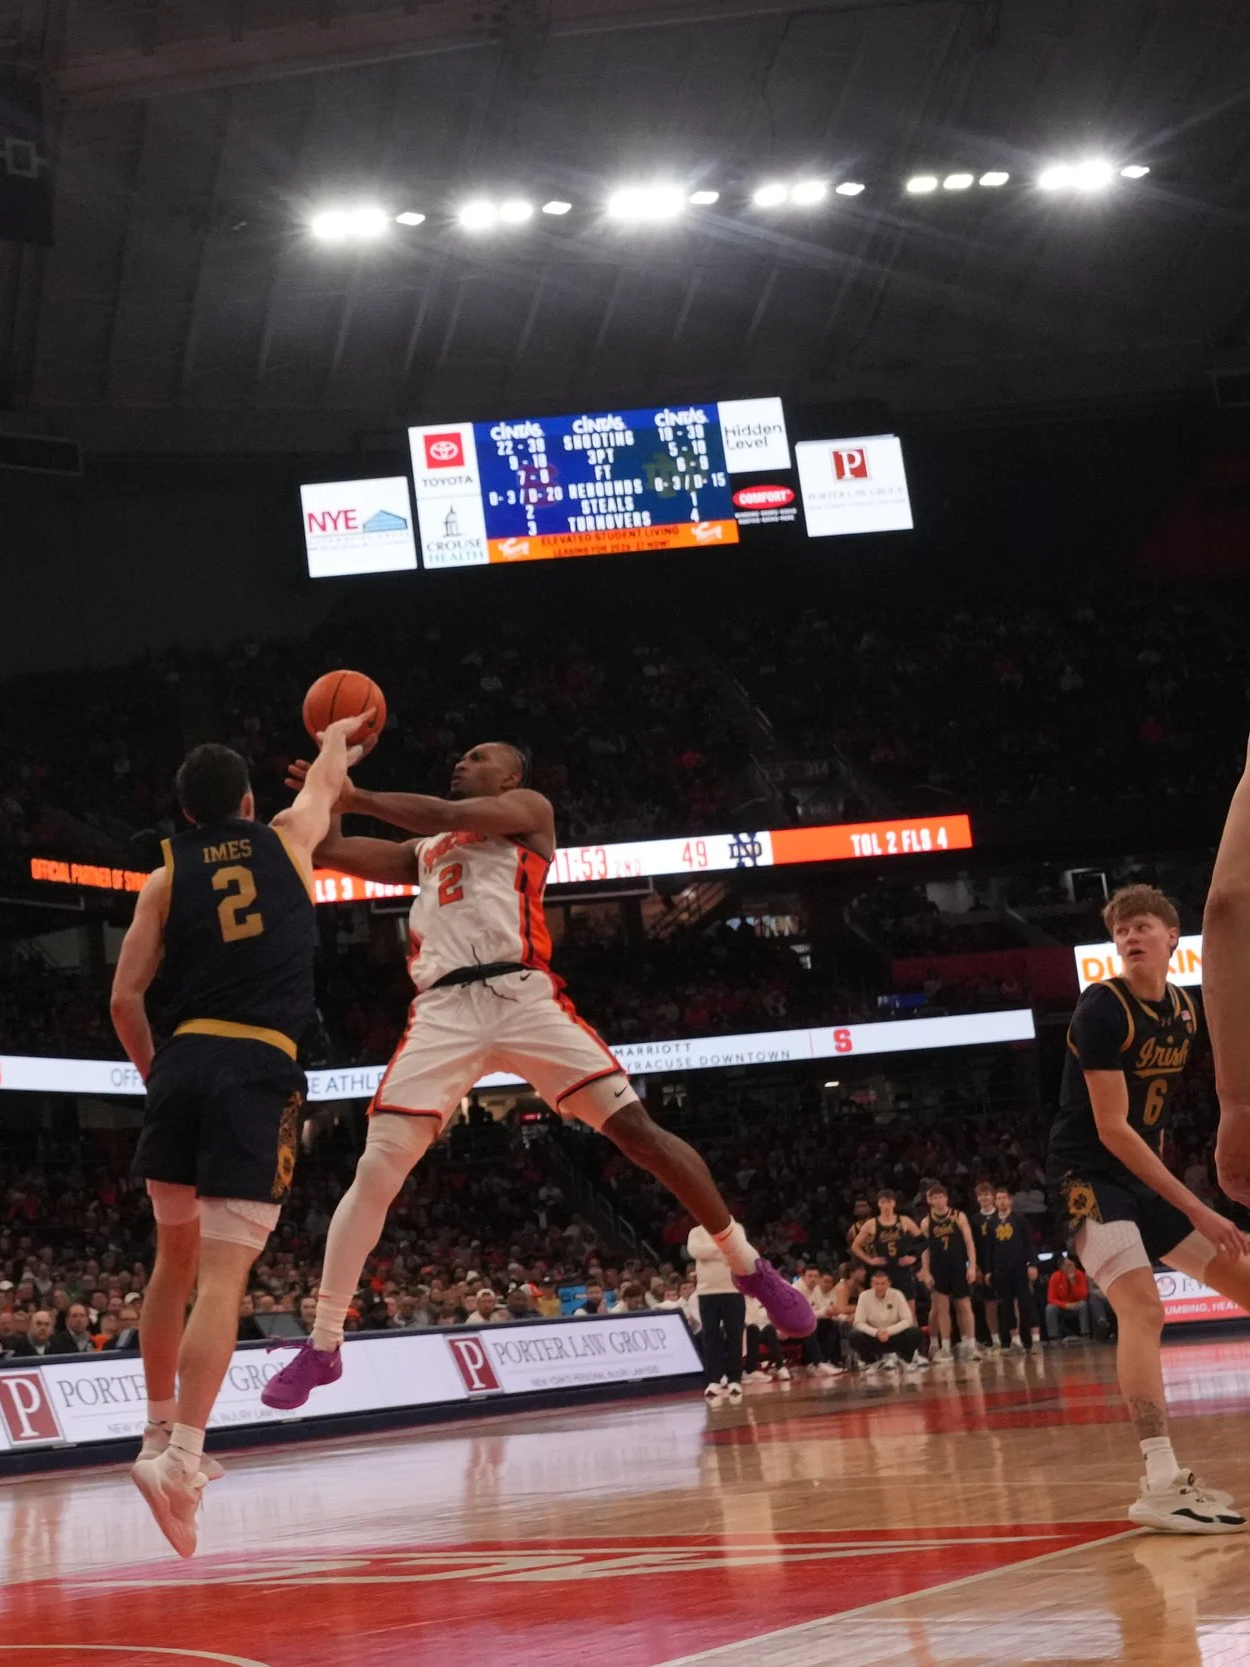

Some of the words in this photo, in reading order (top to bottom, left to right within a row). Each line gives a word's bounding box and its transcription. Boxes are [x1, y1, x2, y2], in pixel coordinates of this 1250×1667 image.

[563, 430, 634, 451] SHOOTING
[724, 423, 782, 438] Hidden
[726, 436, 768, 450] Level
[594, 464, 612, 480] FT
[838, 449, 863, 480] P
[422, 476, 473, 488] TOYOTA
[569, 478, 643, 500] REBOUNDS
[581, 496, 634, 515] STEALS
[739, 490, 787, 504] COMFORT
[307, 509, 358, 533] NYE
[568, 511, 652, 533] TURNOVERS
[427, 538, 481, 552] CROUSE
[429, 549, 484, 563] HEALTH
[203, 838, 252, 864] IMES
[850, 832, 882, 857] TOL
[885, 831, 898, 854] 2
[901, 828, 932, 853] FLS
[937, 826, 948, 850] 4
[682, 840, 708, 869] 49
[438, 862, 464, 907] 2
[211, 865, 265, 943] 2
[614, 1042, 691, 1058] MARRIOTT
[833, 1028, 852, 1053] S
[624, 1056, 692, 1072] YRACUSE
[699, 1049, 790, 1066] DOWNTOWN
[1134, 1036, 1189, 1070] Irish
[1143, 1079, 1168, 1126] 6
[492, 1335, 567, 1366] PORTER
[567, 1333, 607, 1358] LAW
[609, 1328, 667, 1354] GROUP
[454, 1340, 485, 1389] P
[56, 1372, 147, 1408] PORTE
[2, 1377, 41, 1438] P
